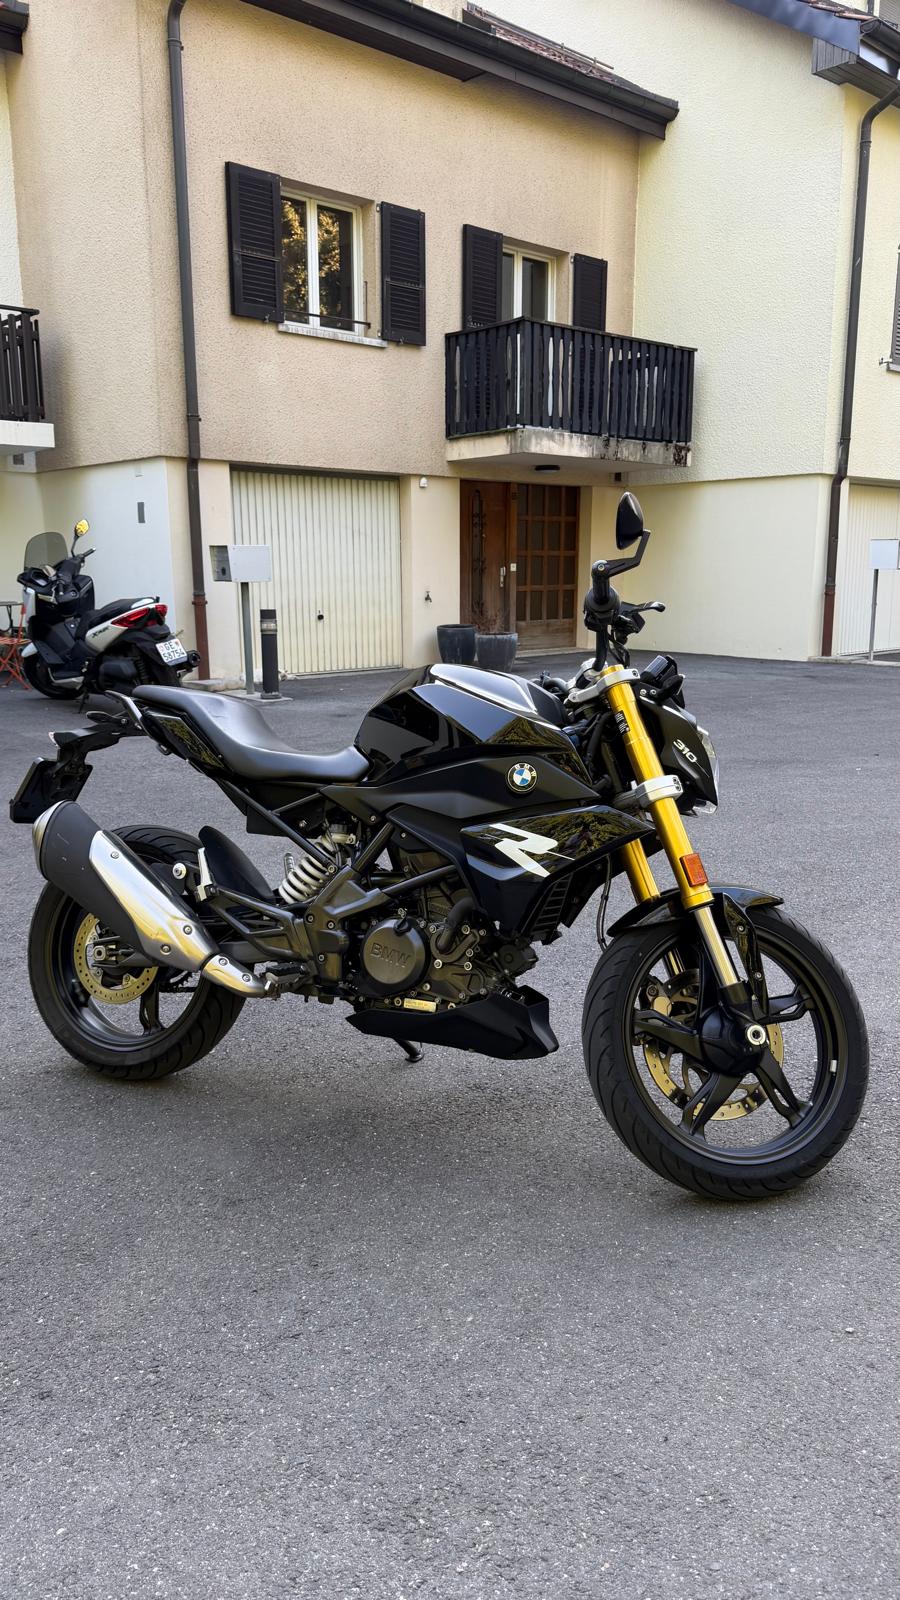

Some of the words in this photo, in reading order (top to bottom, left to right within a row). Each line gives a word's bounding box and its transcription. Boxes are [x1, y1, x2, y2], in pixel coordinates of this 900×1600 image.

[162, 648, 185, 660] 58754
[164, 641, 175, 650] GE
[673, 739, 697, 763] 310
[370, 943, 411, 968] BMW
